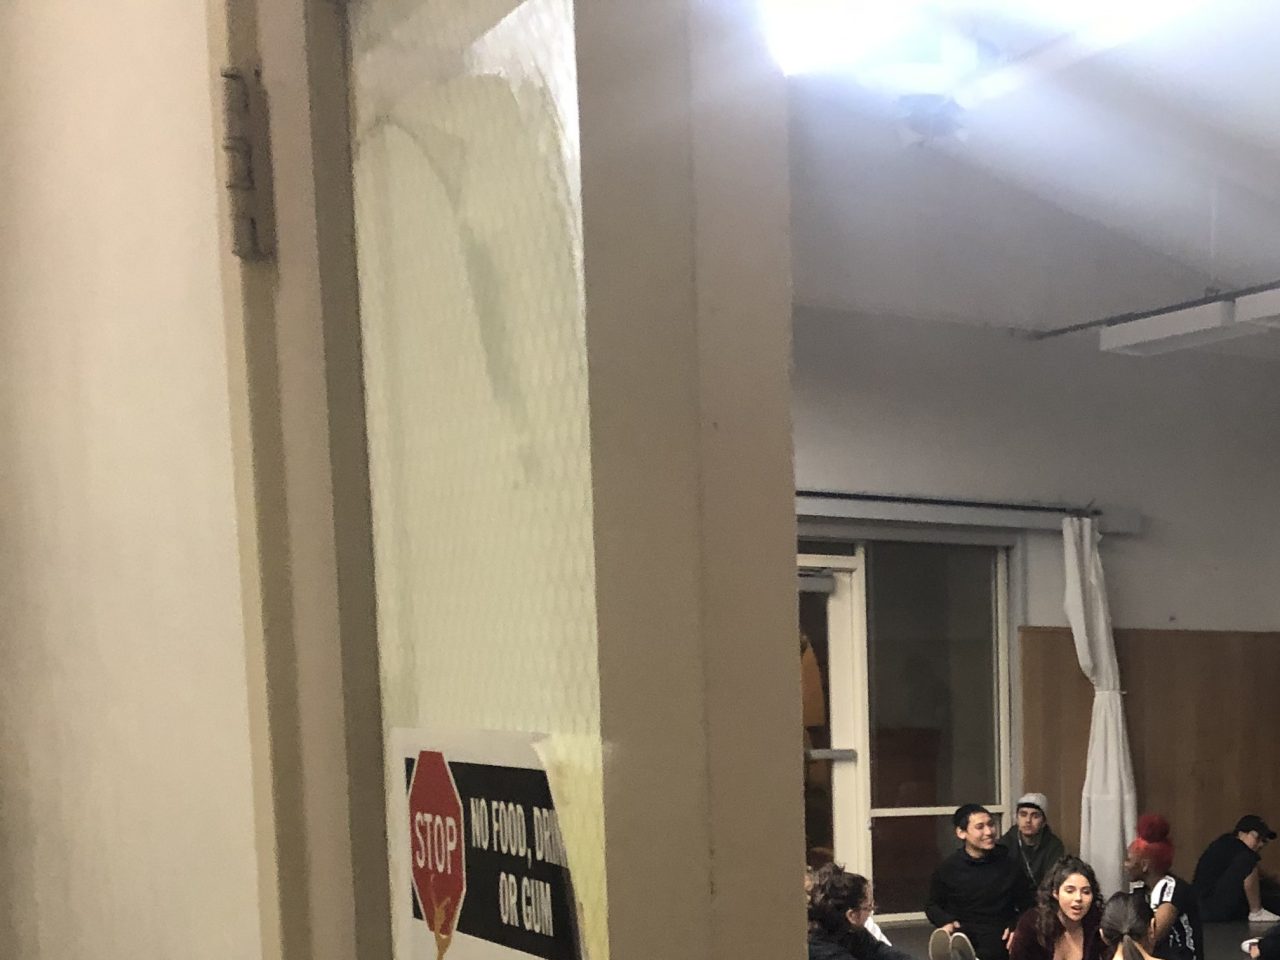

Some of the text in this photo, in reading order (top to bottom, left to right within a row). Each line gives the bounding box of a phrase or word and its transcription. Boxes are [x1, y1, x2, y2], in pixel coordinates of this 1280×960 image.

[415, 811, 457, 875] STOP
[470, 797, 490, 851] NO
[491, 800, 533, 870] FOOD,
[499, 871, 554, 937] OR GUM
